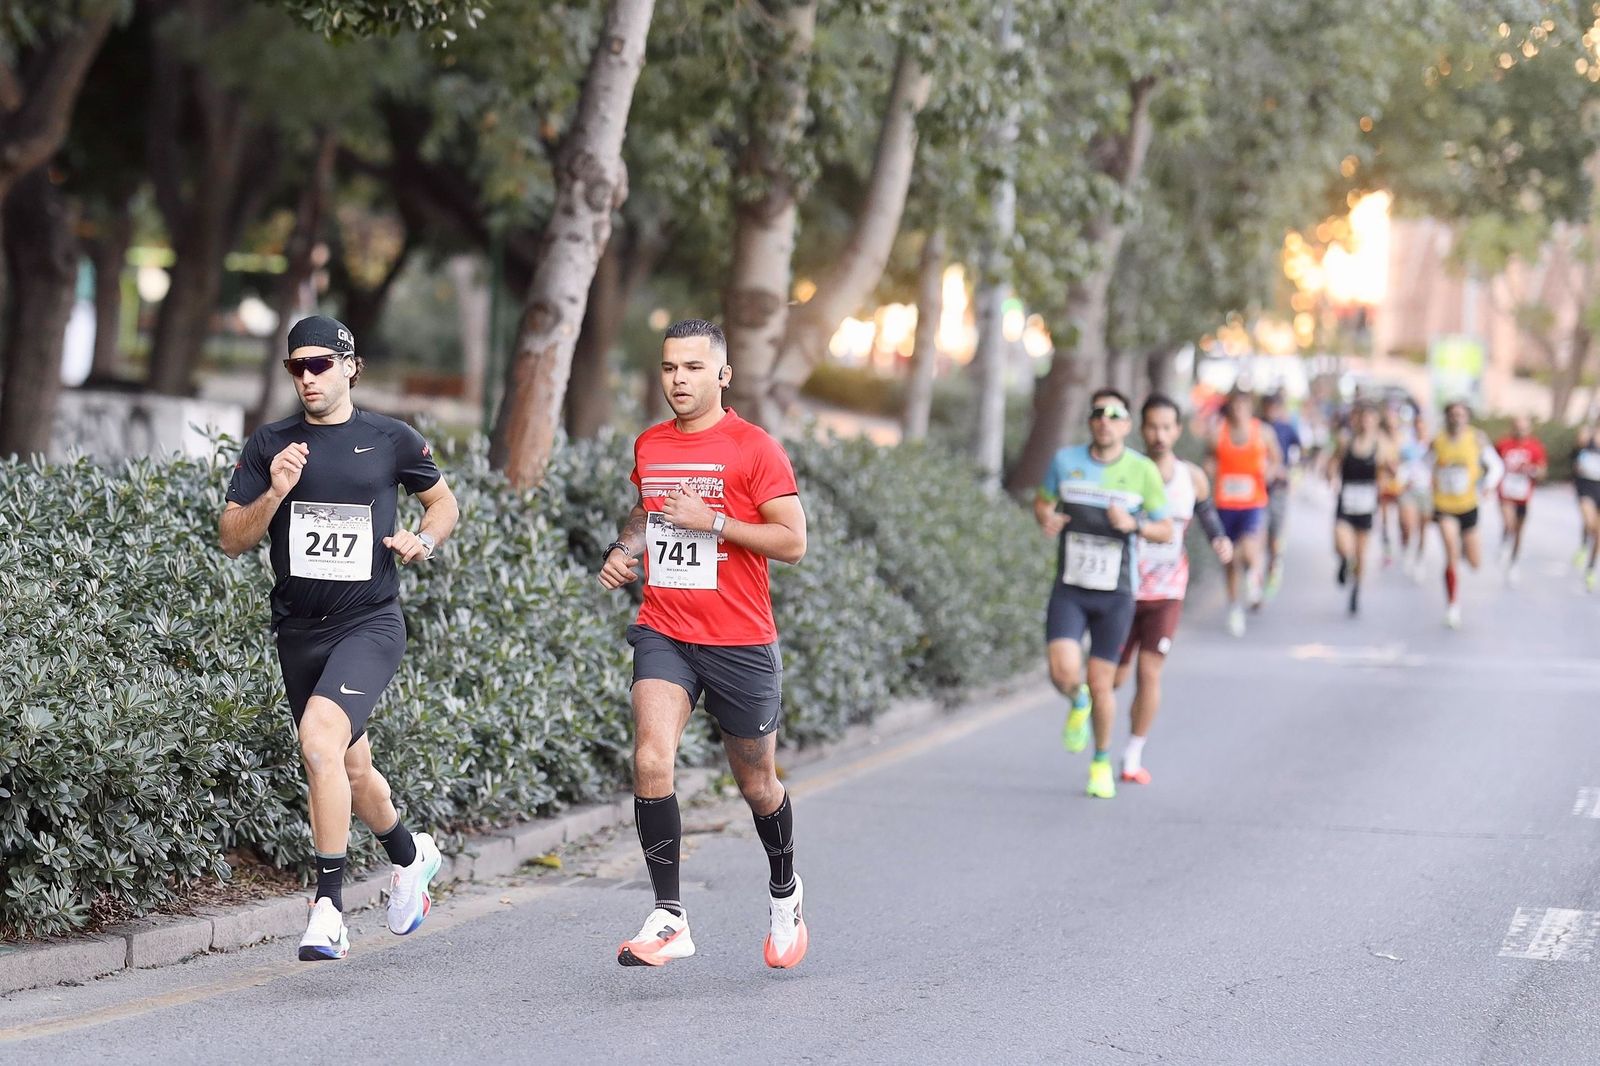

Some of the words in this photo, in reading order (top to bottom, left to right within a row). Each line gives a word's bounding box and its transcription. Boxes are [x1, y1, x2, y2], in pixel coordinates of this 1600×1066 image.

[687, 477, 724, 485] CARRERA
[306, 532, 358, 557] 247
[655, 541, 701, 566] 741
